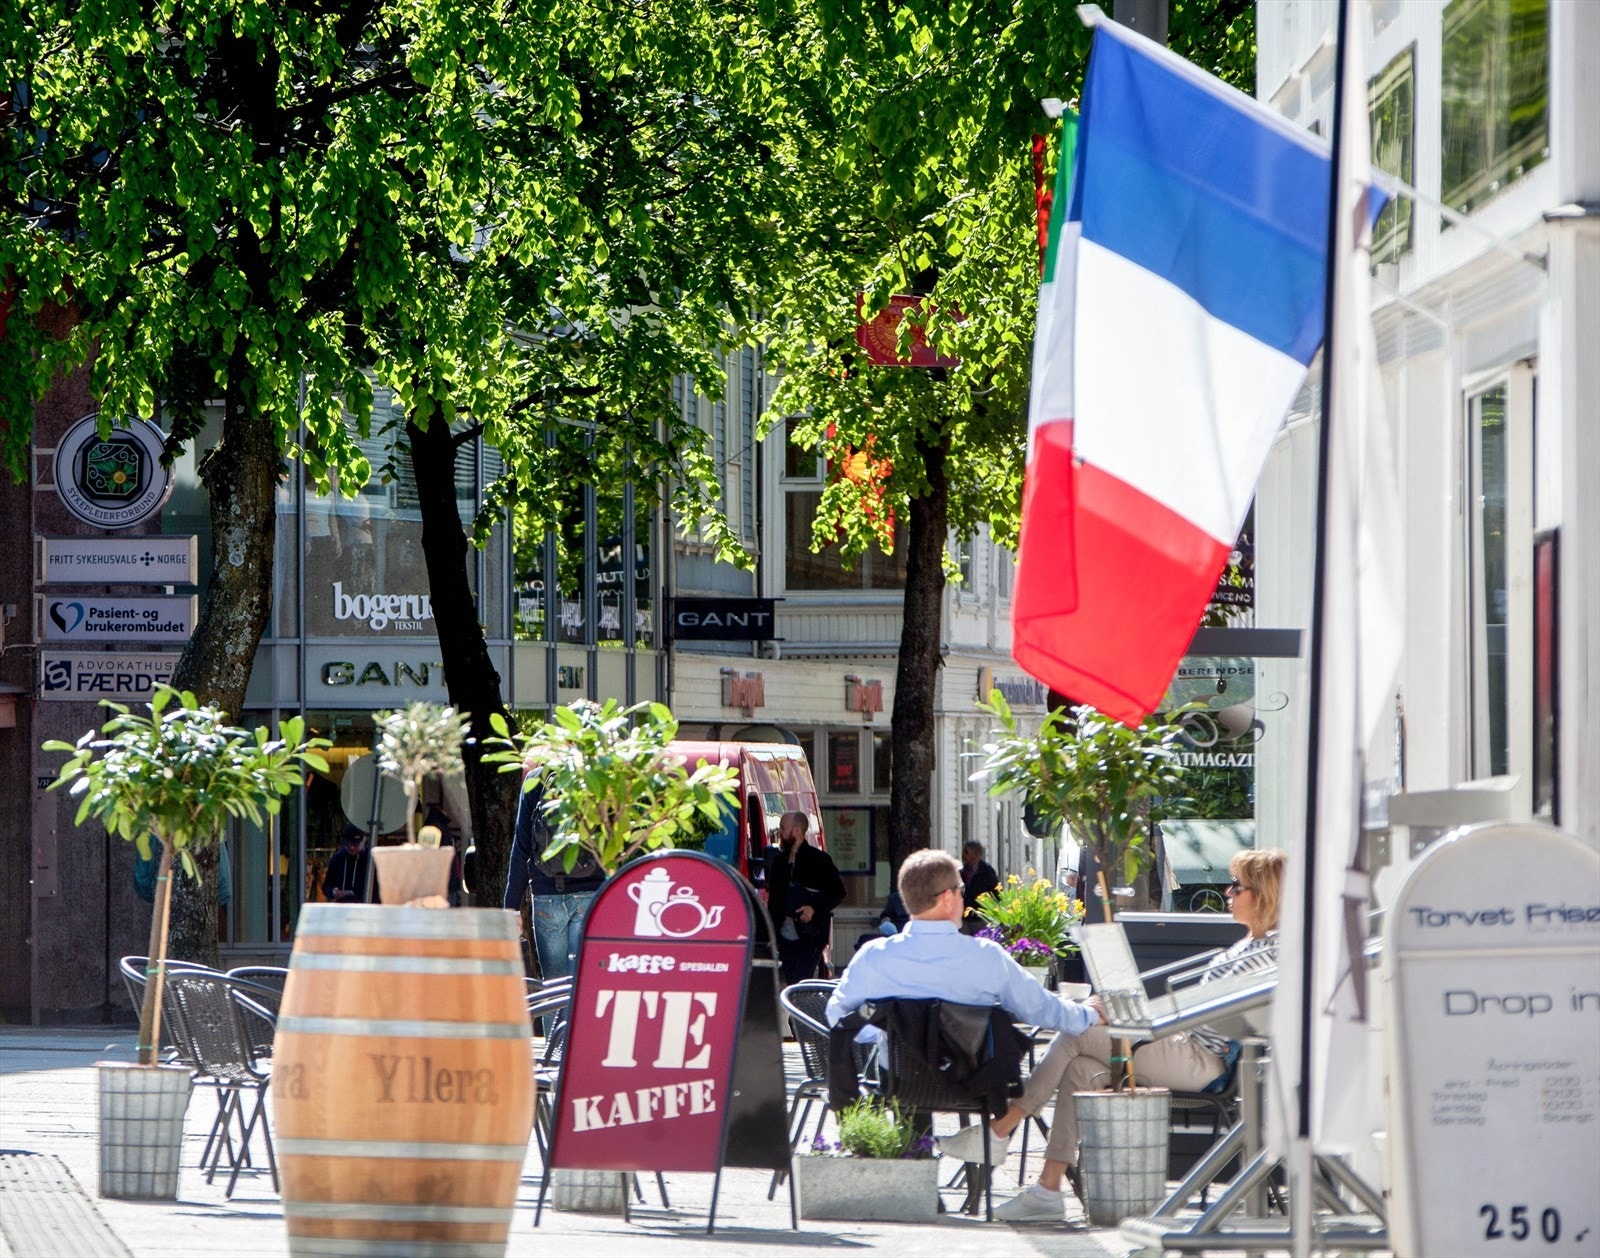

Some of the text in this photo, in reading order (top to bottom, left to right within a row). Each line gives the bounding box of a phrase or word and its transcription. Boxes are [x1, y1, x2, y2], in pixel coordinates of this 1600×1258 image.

[67, 487, 155, 520] SYKEPLEIERFORBUND
[50, 554, 187, 565] FRITT SYKEHUSVALG NORGE
[89, 607, 159, 621] Pasient- og
[678, 612, 770, 626] GANT
[85, 621, 185, 632] brukerombudet
[394, 621, 424, 630] TEKSTIL
[1409, 906, 1516, 928] Torvet
[607, 953, 676, 974] kaffe
[1444, 986, 1600, 1019] Drop in
[595, 990, 718, 1069] TE
[571, 1079, 717, 1132] KAFFE
